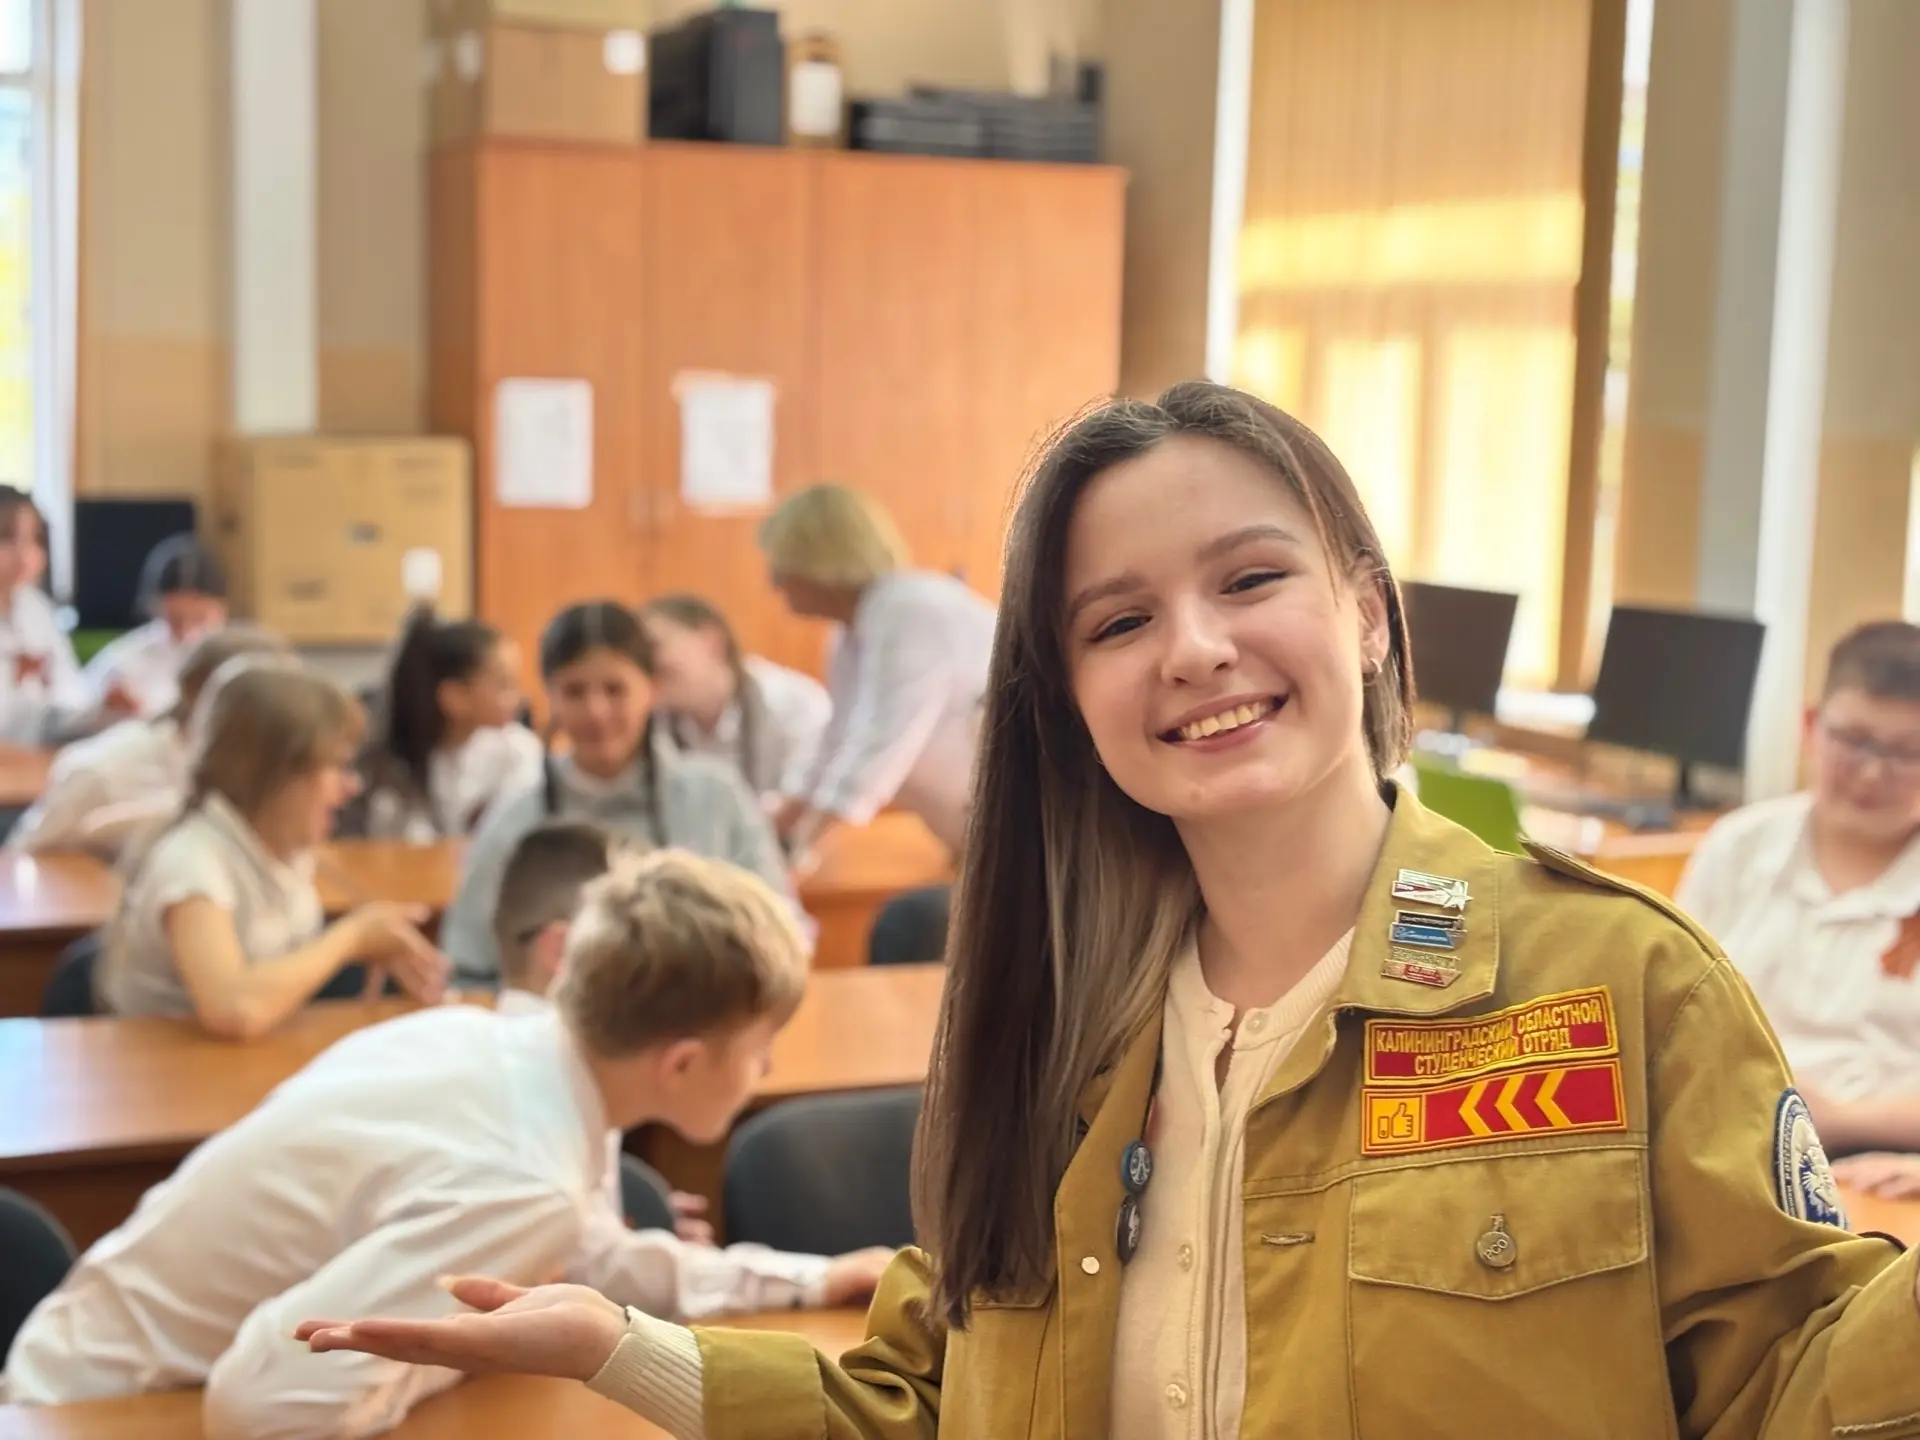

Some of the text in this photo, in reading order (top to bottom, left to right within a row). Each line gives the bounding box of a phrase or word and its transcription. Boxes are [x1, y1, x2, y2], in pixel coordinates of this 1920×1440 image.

[1376, 999, 1602, 1052] КАЛИНИНГРАДСКИЙ ОБЛАСТНОЙ
[1415, 1028, 1571, 1074] СТУДЕНЧЕСКИЙ ОТРЯД
